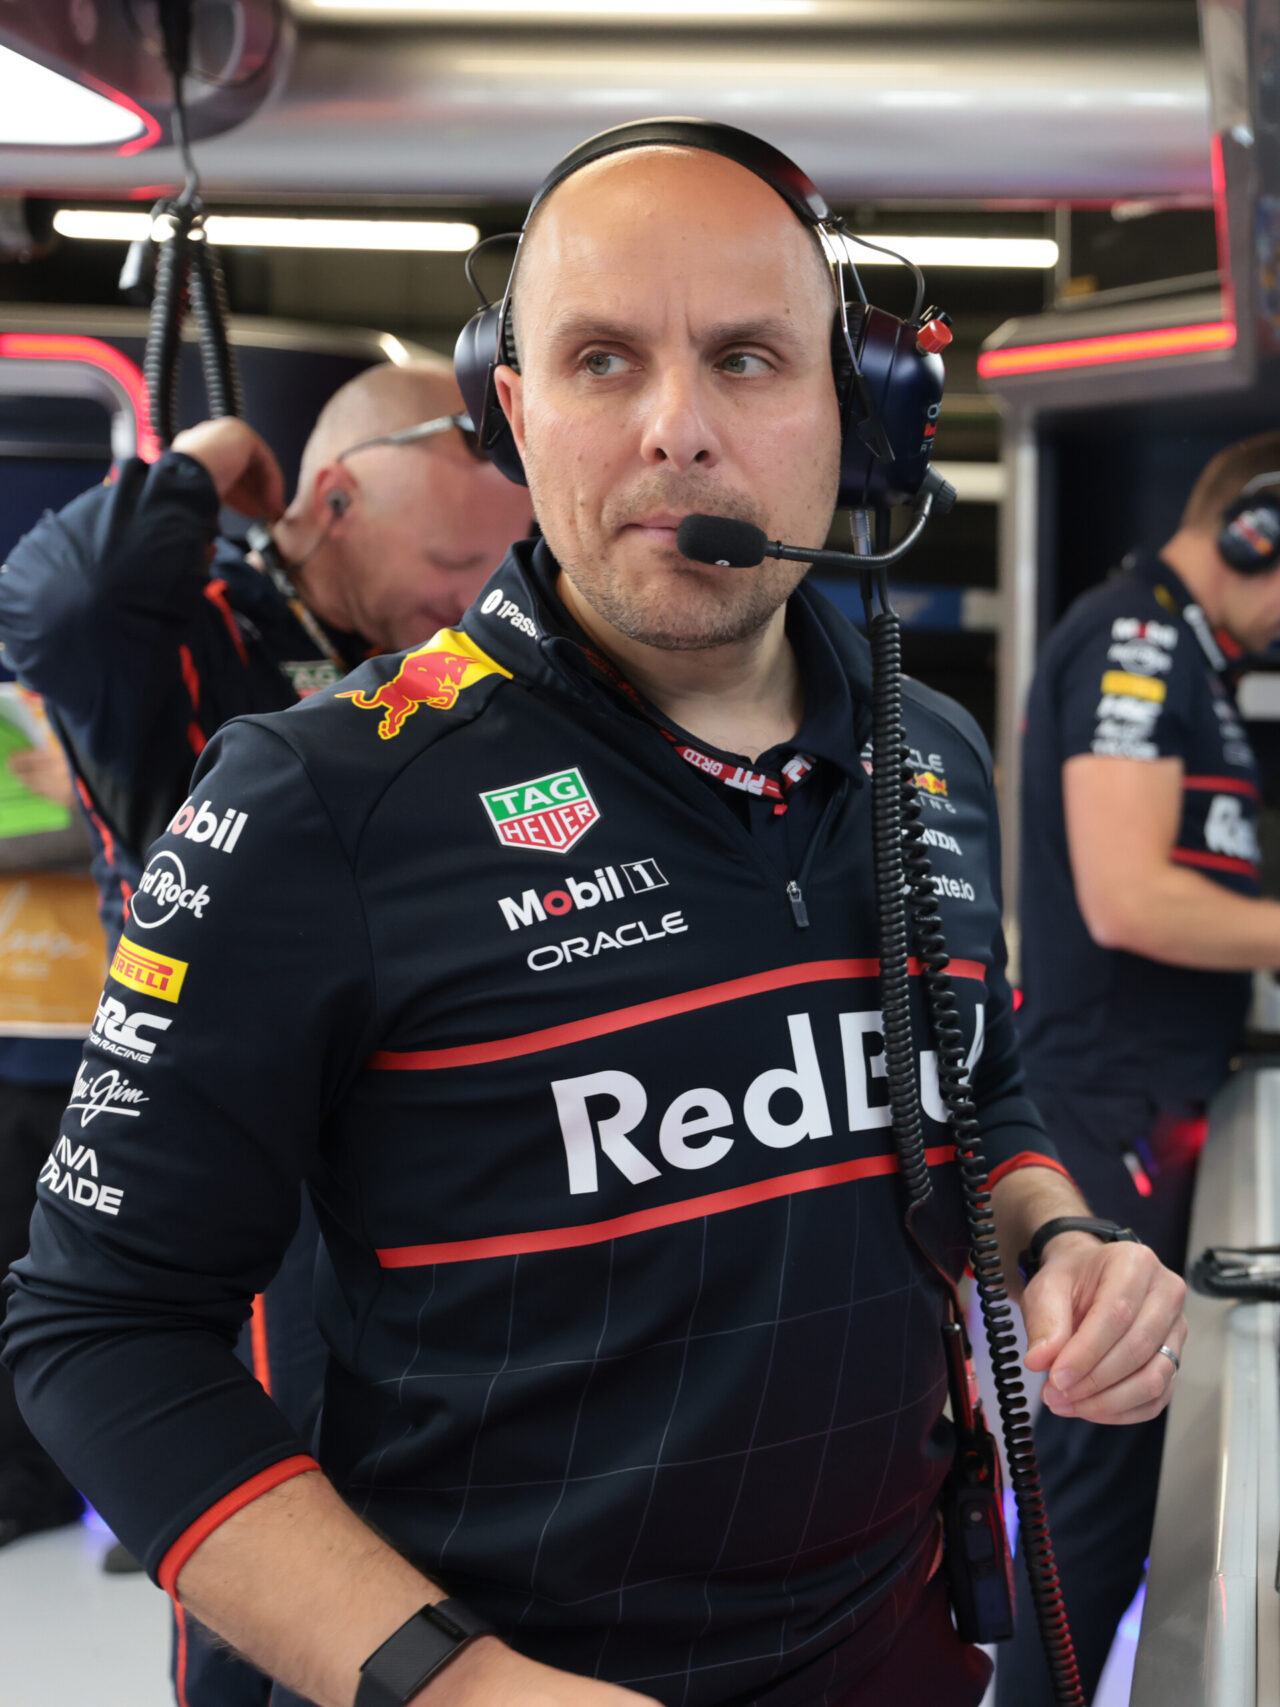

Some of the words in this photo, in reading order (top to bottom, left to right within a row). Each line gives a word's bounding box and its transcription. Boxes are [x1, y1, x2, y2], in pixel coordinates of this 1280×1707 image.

[497, 600, 540, 640] 1Pass
[683, 748, 723, 776] GRID
[491, 777, 580, 815] TAG
[166, 796, 249, 854] obil
[503, 803, 593, 847] HEUER
[152, 871, 210, 918] Rock
[498, 866, 625, 931] Mobil
[632, 863, 655, 889] 1
[527, 910, 689, 971] ORACLE
[99, 1040, 151, 1064] RACING
[39, 1154, 124, 1216] TRADE
